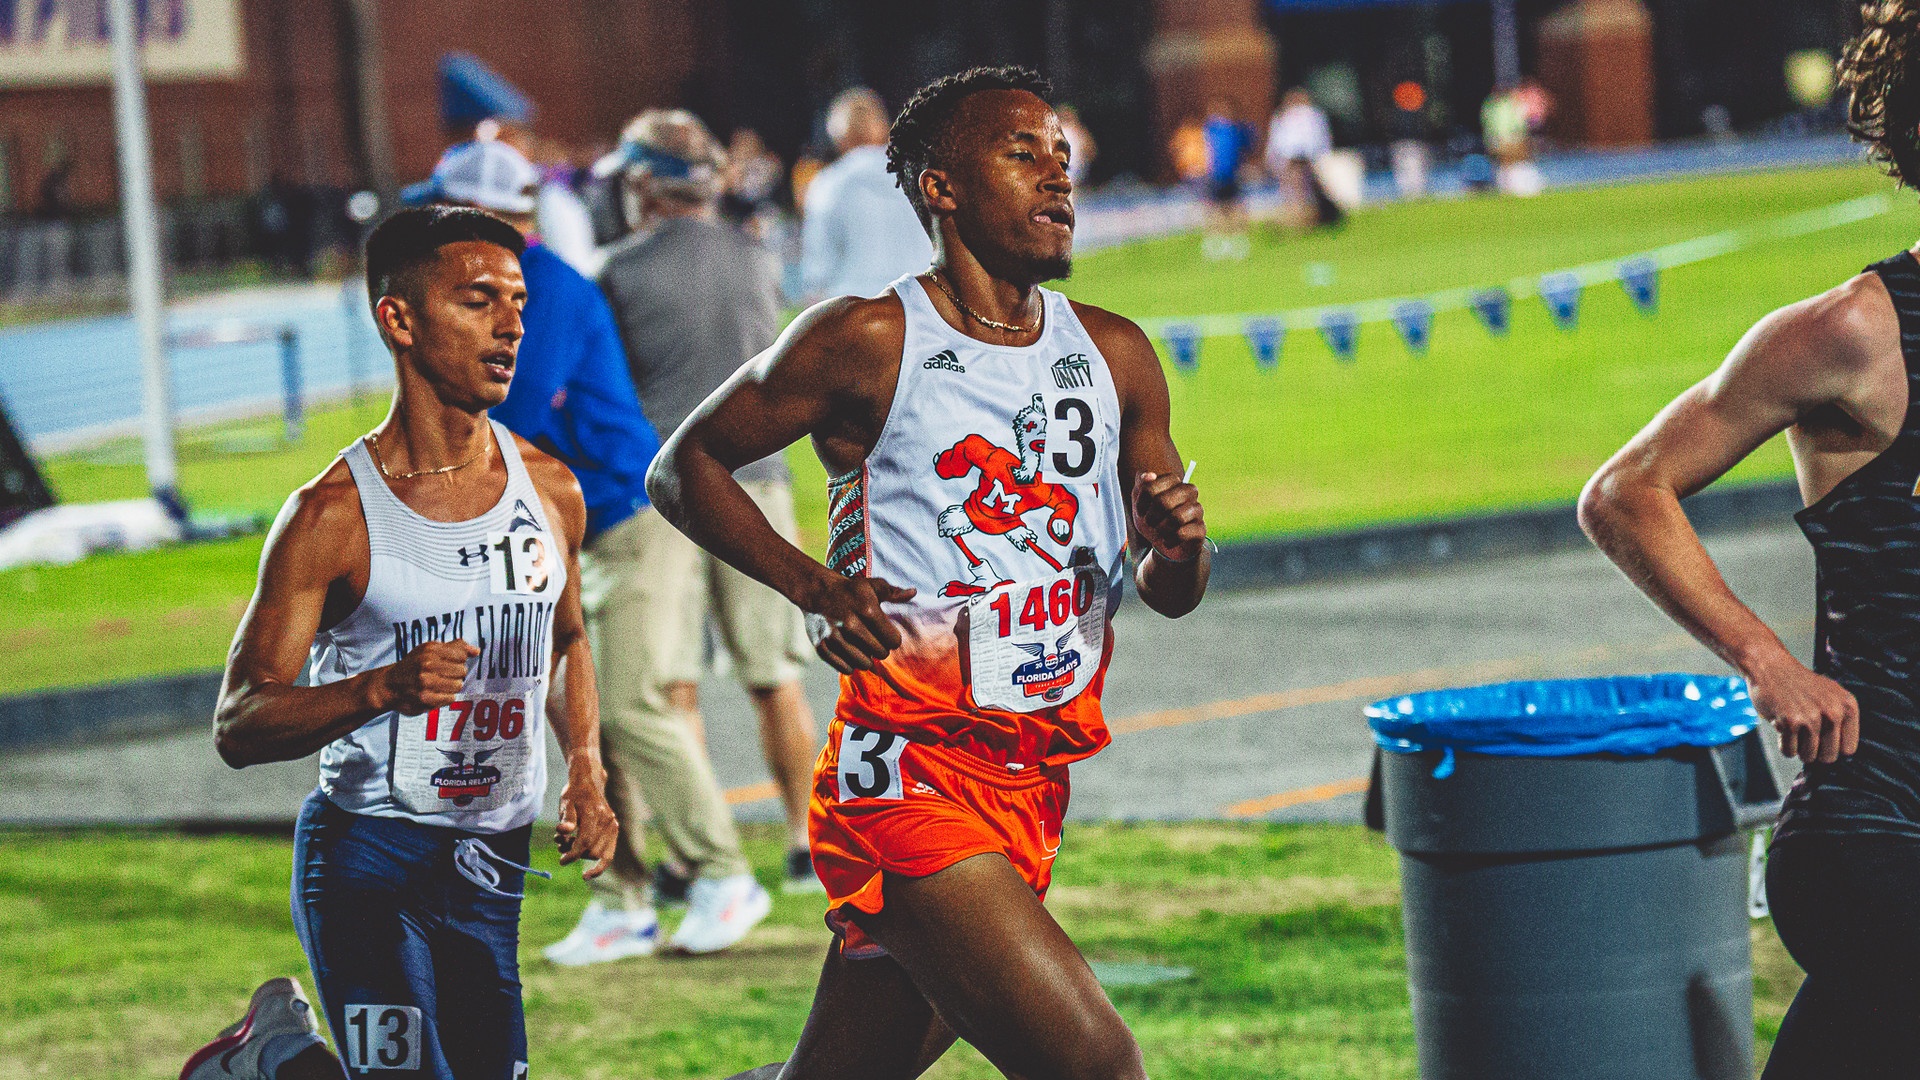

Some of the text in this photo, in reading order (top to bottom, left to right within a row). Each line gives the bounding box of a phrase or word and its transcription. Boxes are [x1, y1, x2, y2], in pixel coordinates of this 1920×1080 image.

[923, 359, 966, 374] adidas
[1051, 364, 1094, 389] UNITY
[1053, 353, 1090, 368] ACC
[1052, 397, 1097, 478] 3
[981, 477, 1023, 515] M
[494, 536, 549, 593] 13
[990, 570, 1094, 638] 1460
[1016, 659, 1078, 684] FLORIDA RELAYS
[425, 698, 525, 742] 1796
[434, 776, 497, 786] FLORIDA RELAYS
[844, 725, 891, 798] 3
[350, 1008, 409, 1067] 13
